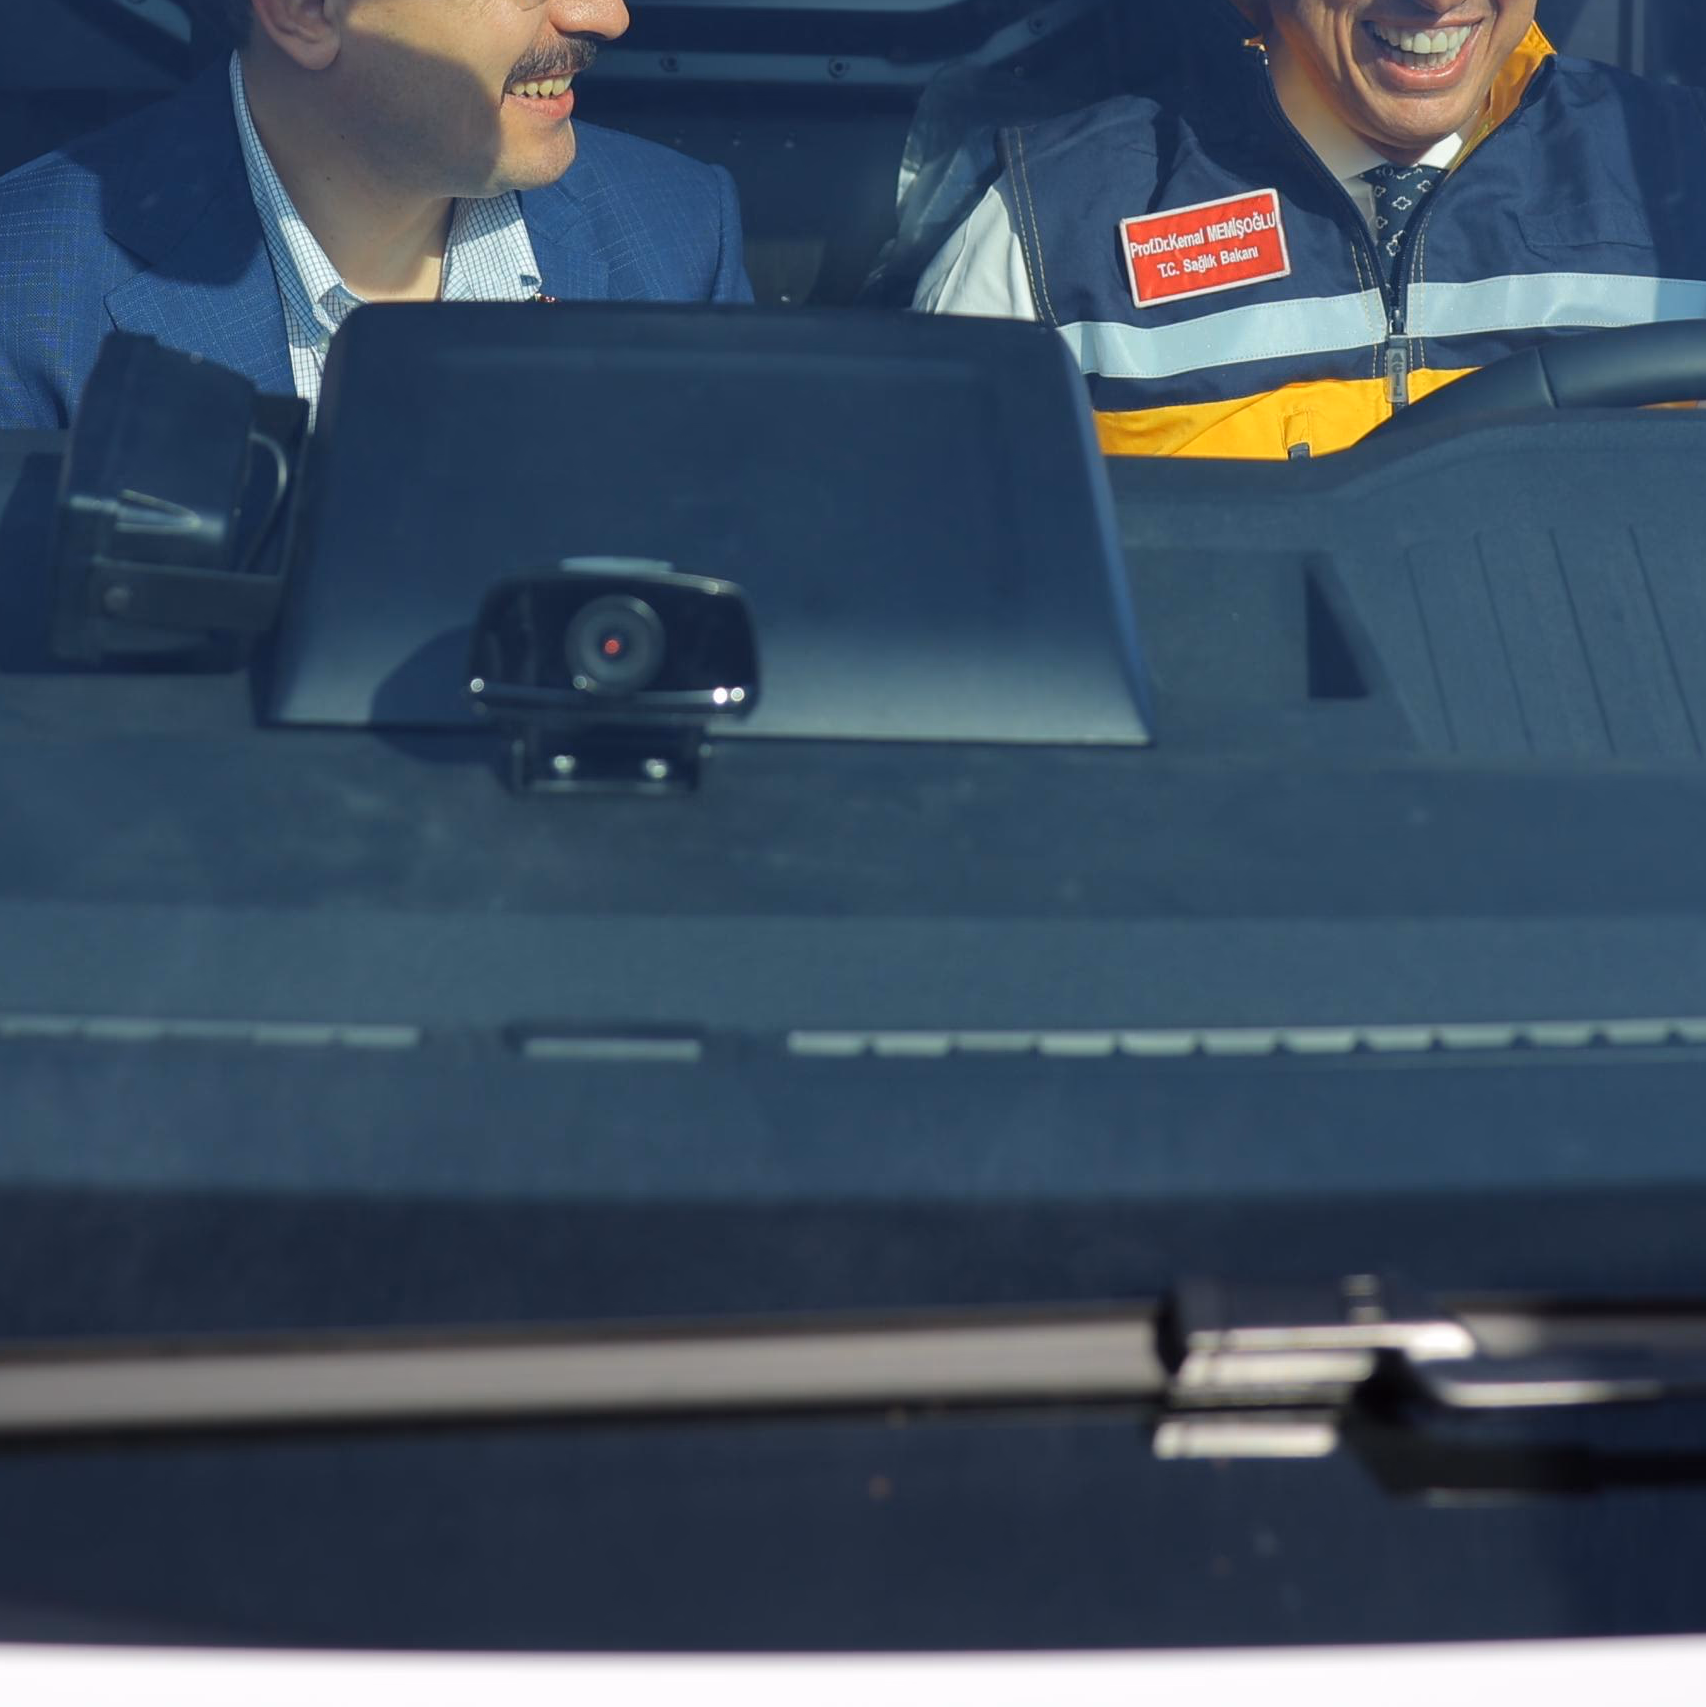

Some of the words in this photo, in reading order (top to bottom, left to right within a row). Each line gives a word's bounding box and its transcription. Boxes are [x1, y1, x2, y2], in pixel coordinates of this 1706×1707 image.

[1206, 211, 1276, 243] MEMİŞOĞLU
[1157, 262, 1180, 278] T.C.
[1183, 256, 1218, 274] Sağlık
[1220, 246, 1259, 265] Bakanı
